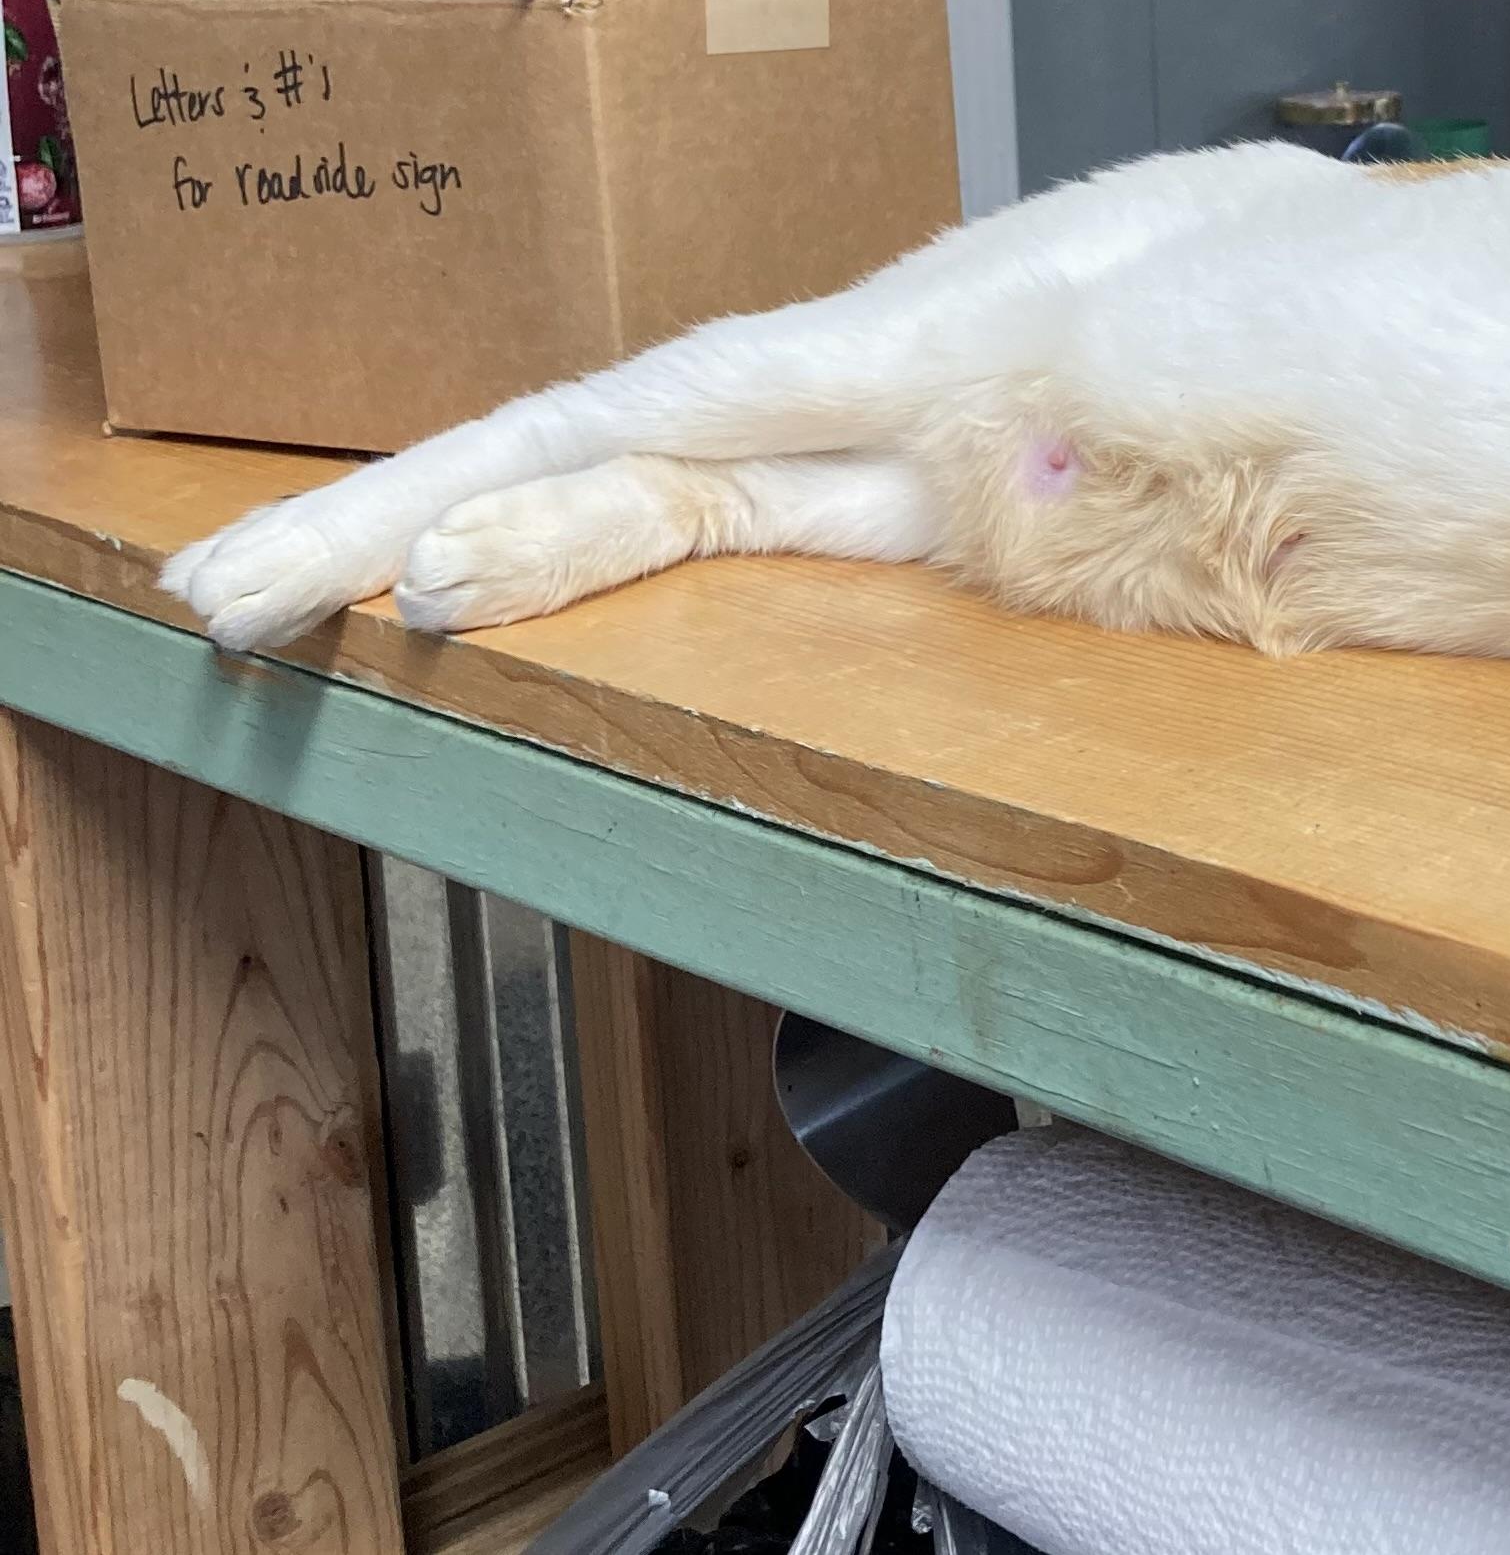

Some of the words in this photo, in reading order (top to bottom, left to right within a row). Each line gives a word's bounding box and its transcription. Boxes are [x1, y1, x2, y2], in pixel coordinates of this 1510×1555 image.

[130, 67, 226, 128] Letters
[173, 155, 213, 212] for
[391, 152, 463, 216] sign
